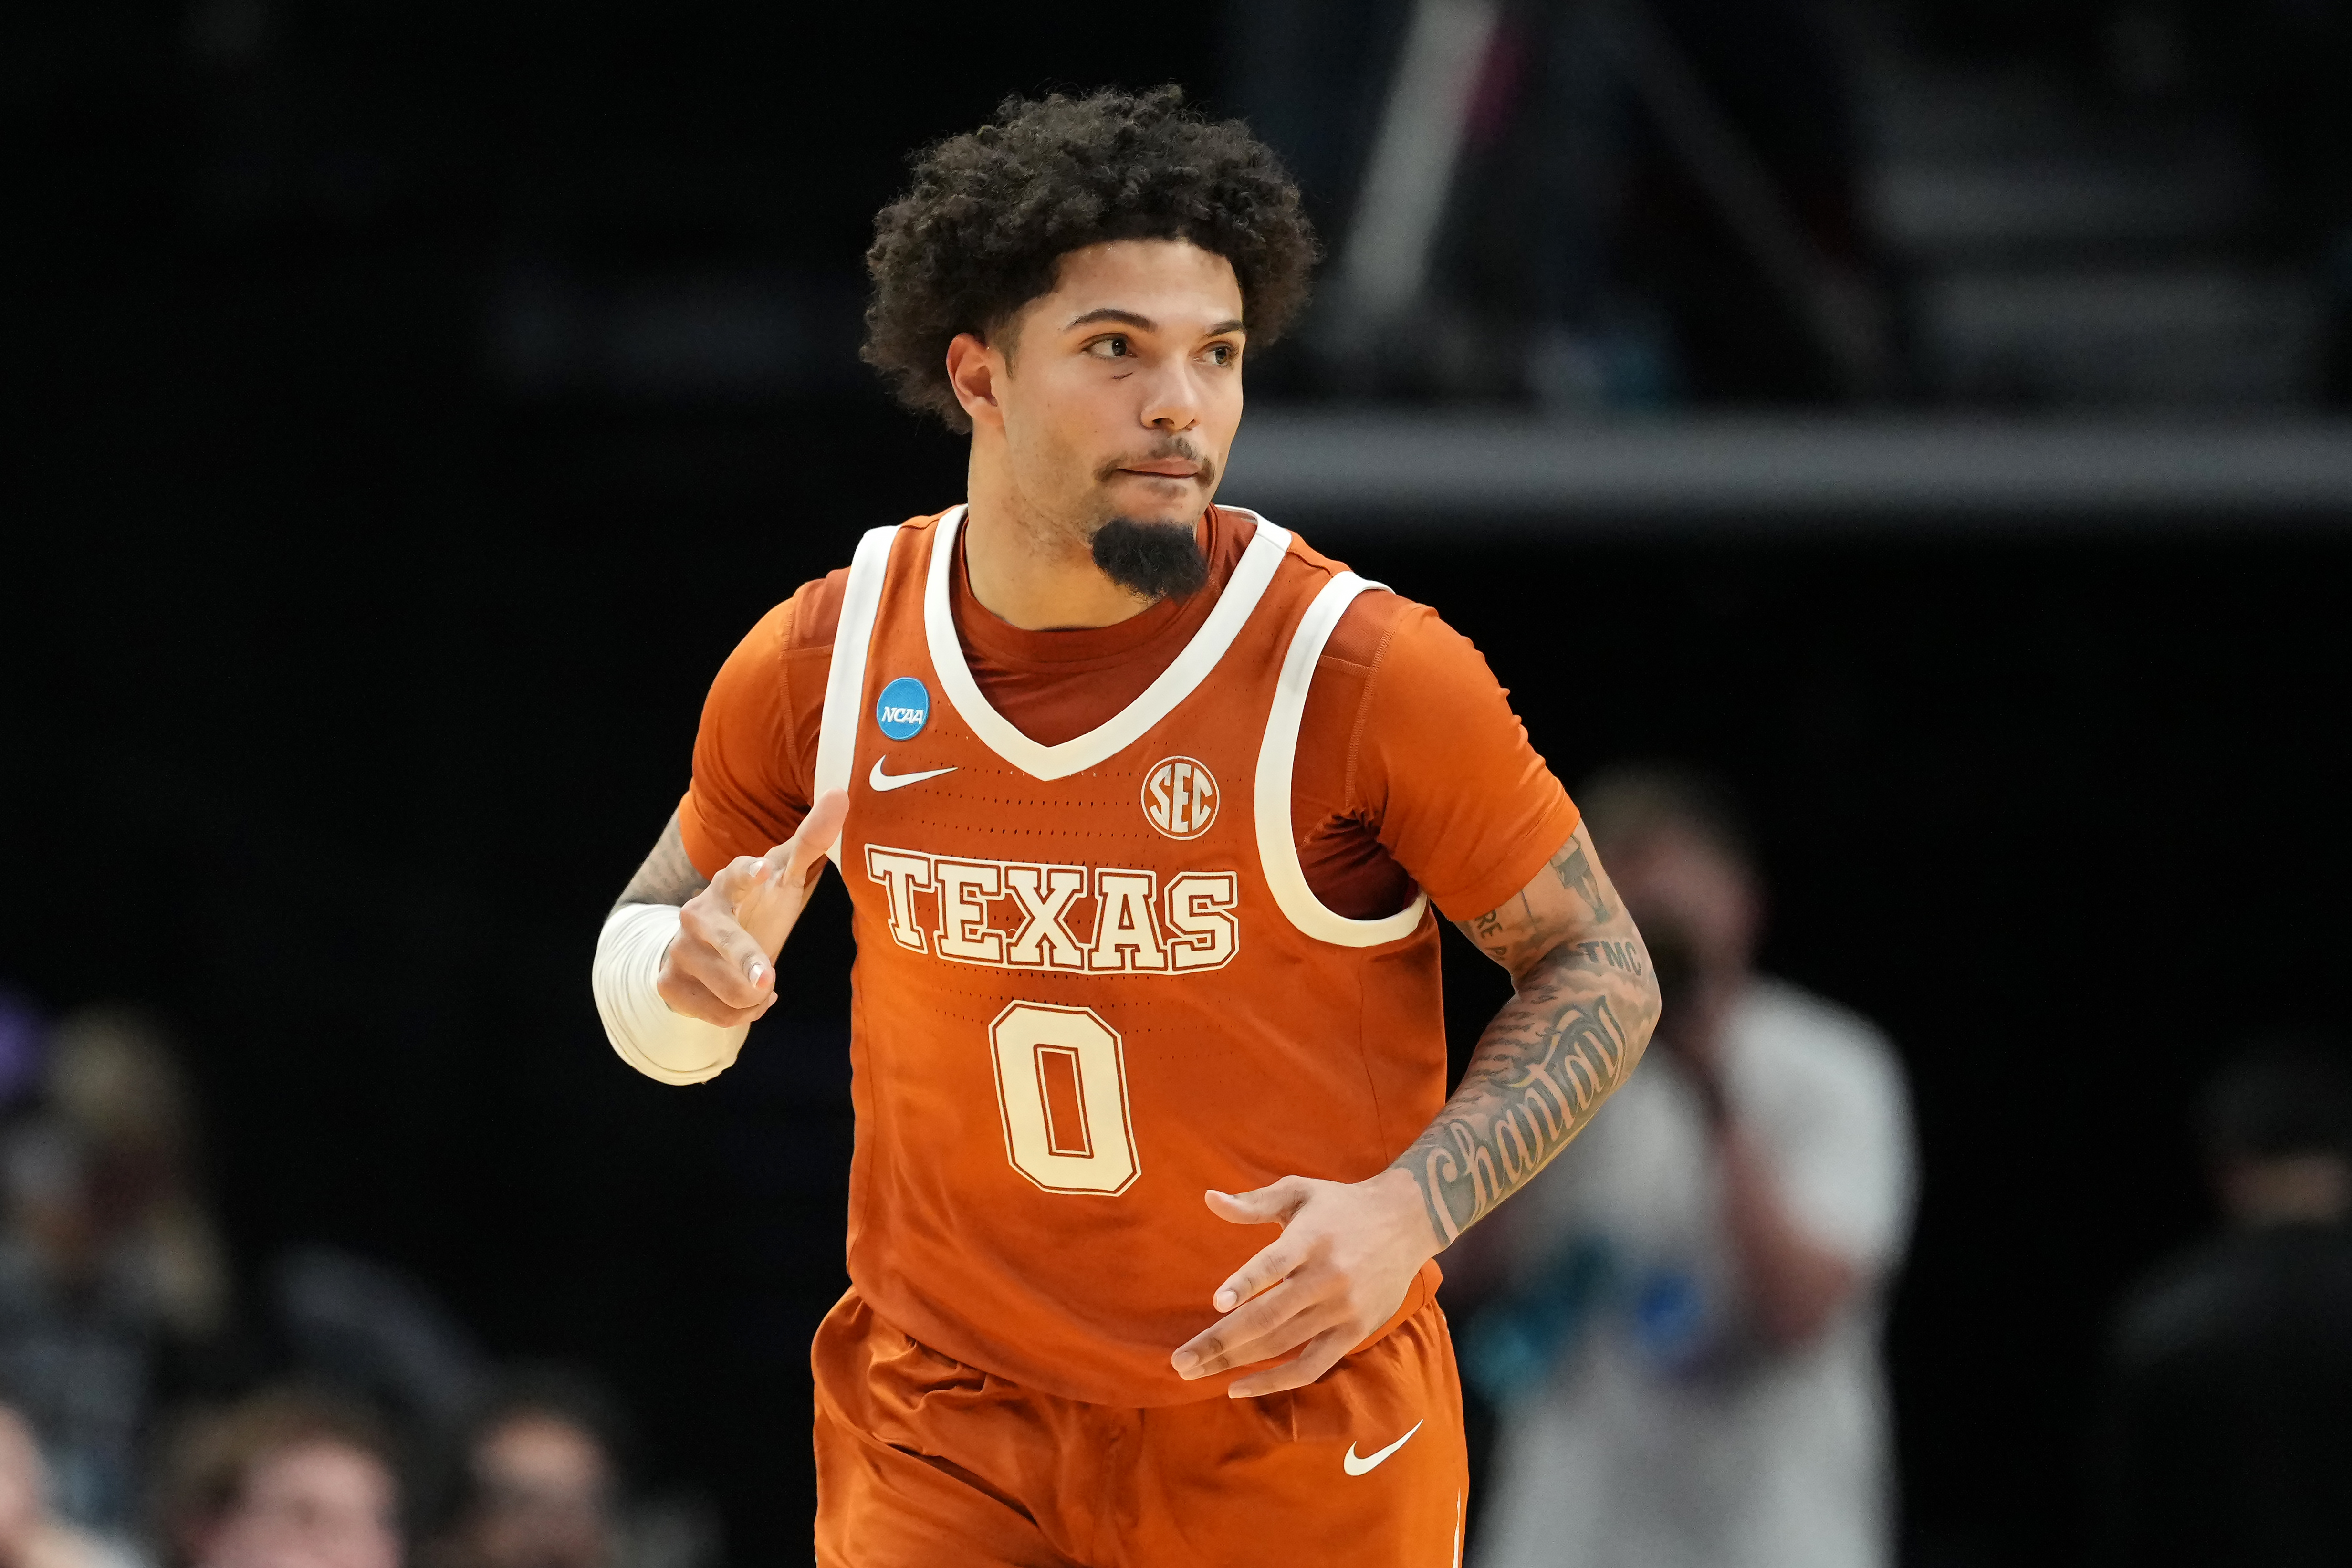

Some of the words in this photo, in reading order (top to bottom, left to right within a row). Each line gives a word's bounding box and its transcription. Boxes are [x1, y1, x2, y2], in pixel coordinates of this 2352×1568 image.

[881, 706, 924, 725] NCAA
[1149, 763, 1213, 833] SEC
[864, 843, 1239, 975] TEXAS
[1576, 941, 1641, 976] TMC
[988, 999, 1142, 1197] 0
